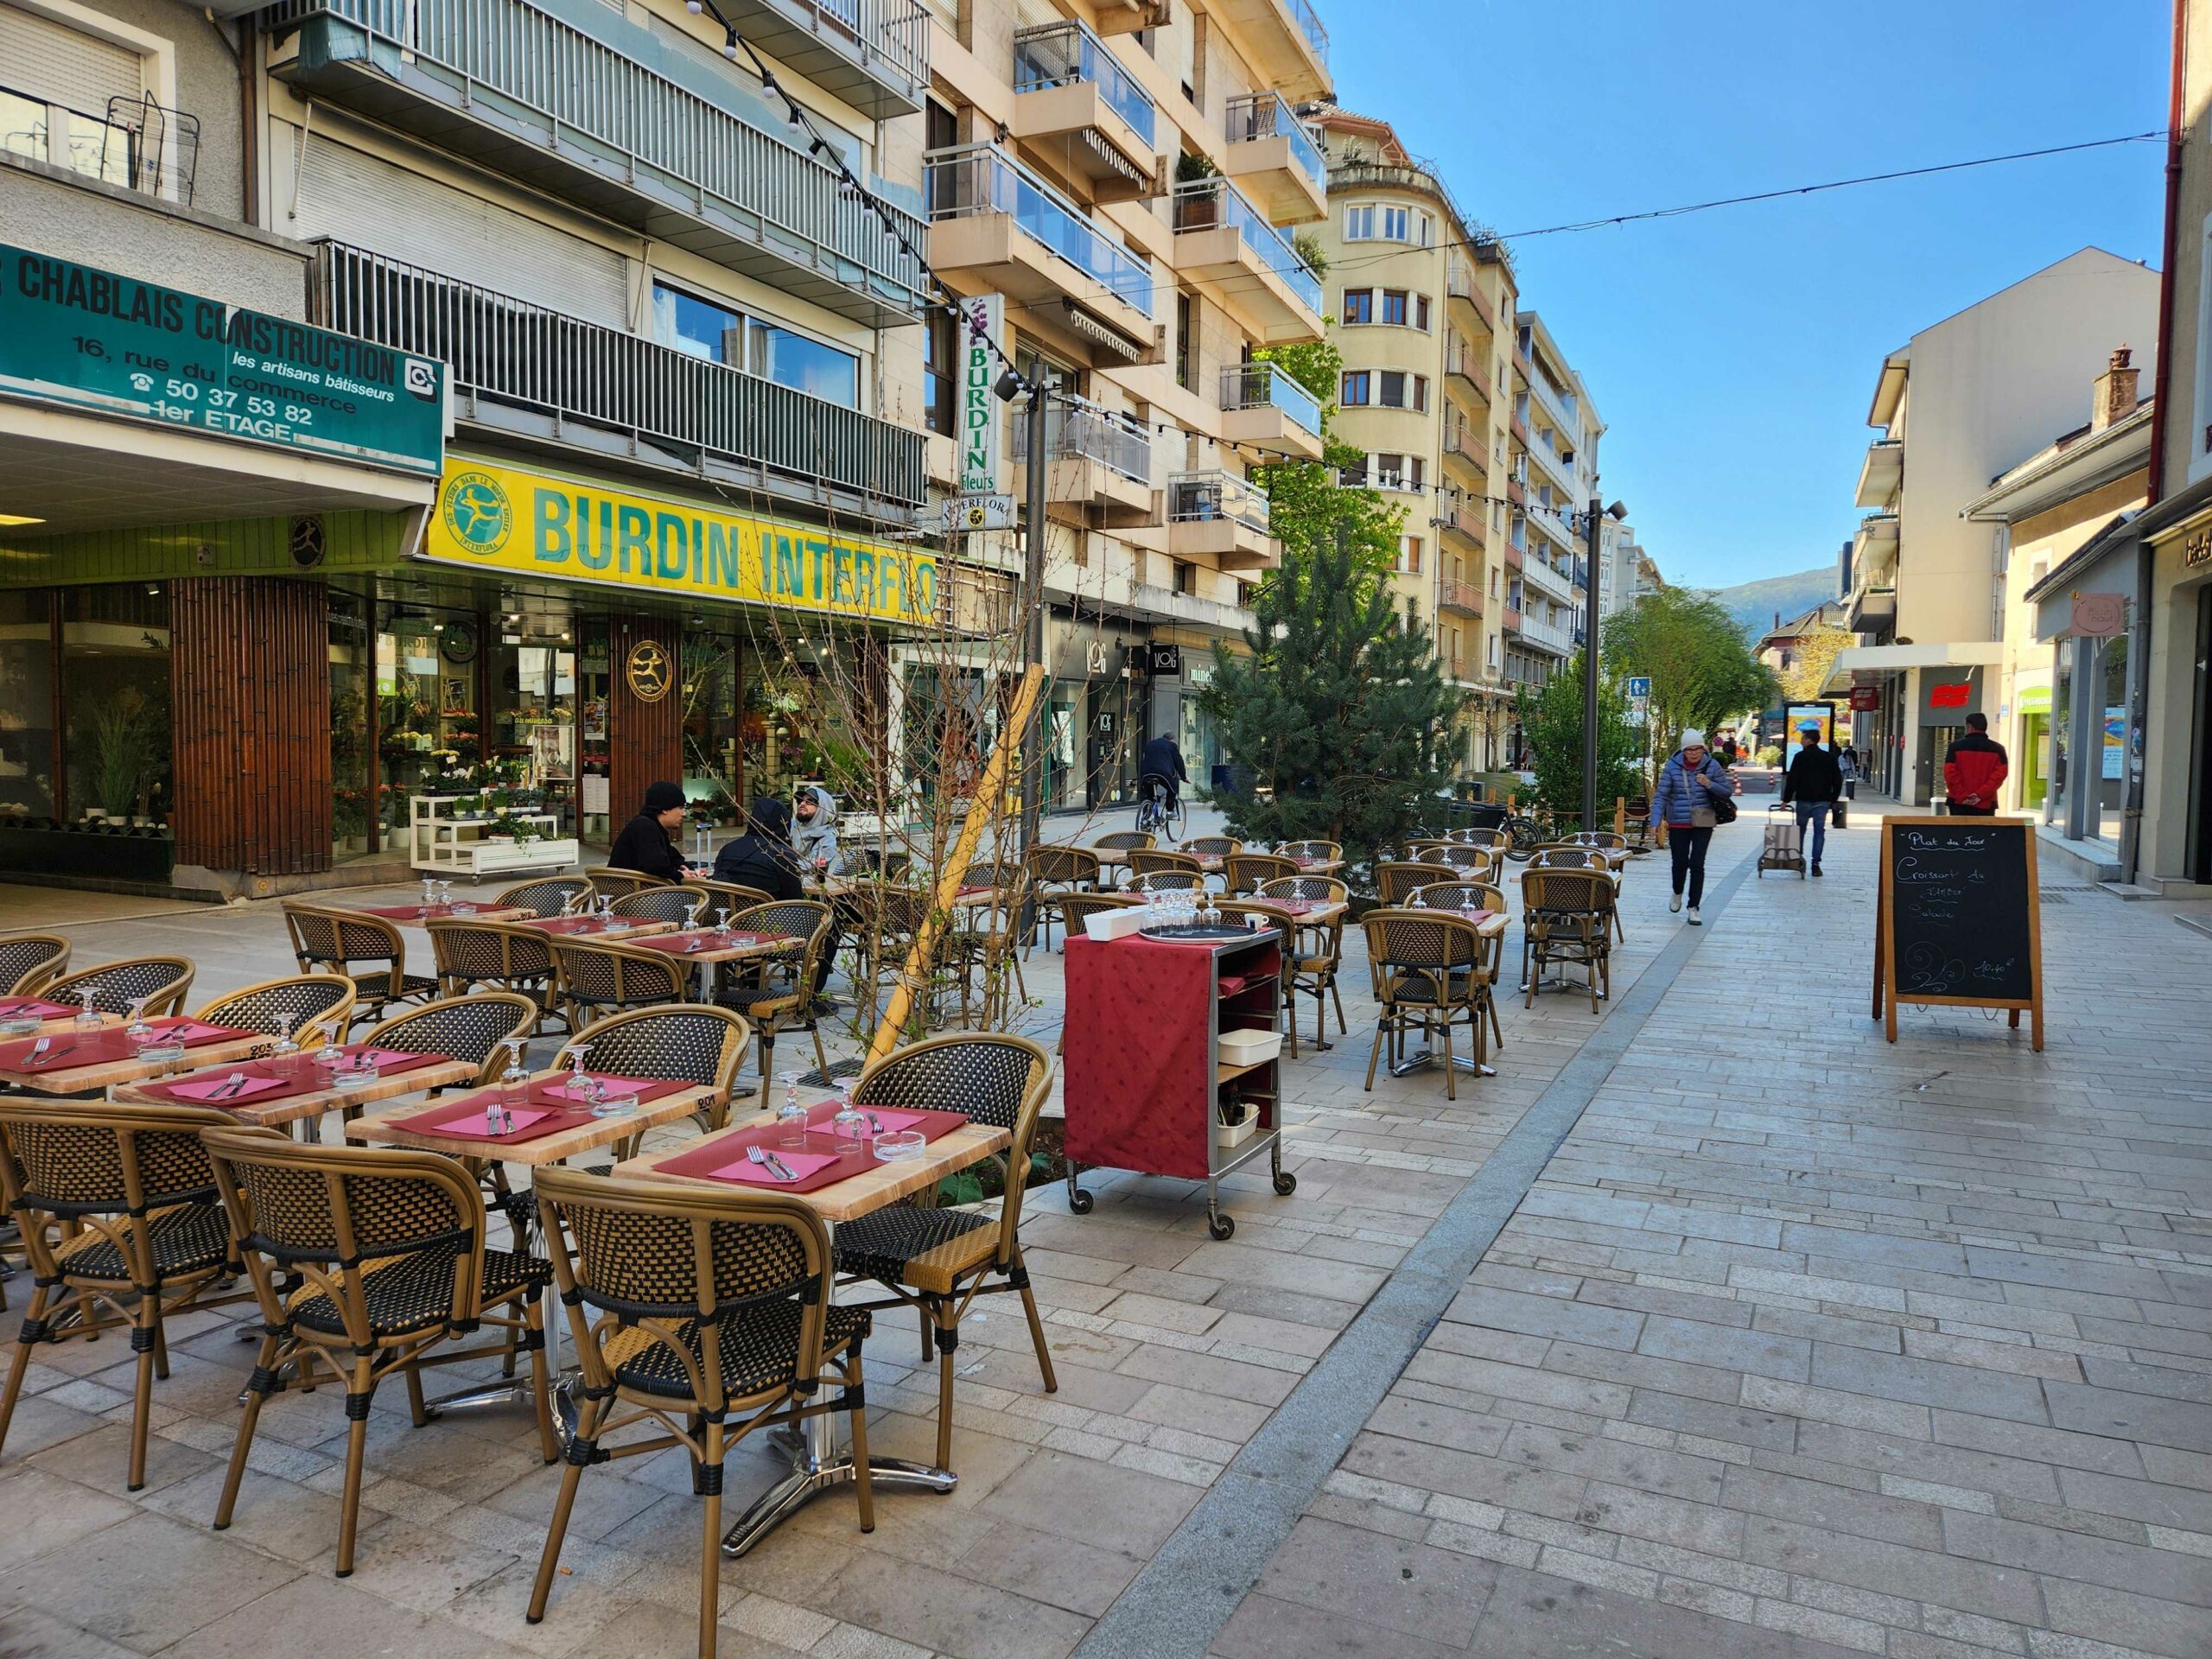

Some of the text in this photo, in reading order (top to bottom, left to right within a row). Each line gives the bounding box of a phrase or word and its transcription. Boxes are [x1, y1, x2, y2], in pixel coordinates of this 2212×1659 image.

[18, 256, 395, 386] CHABLAIS CONSTRUCTION
[72, 336, 356, 414] 16, rue du commerce
[232, 352, 395, 403] les artisans bâtisseurs
[166, 378, 313, 425] 50 37 53 82
[968, 347, 988, 470] BURDIN
[154, 400, 291, 442] 1er ETAGE
[960, 474, 994, 490] Fleurs
[944, 499, 1009, 520] IERFLORA
[534, 487, 937, 616] BURDIN INTERFLO
[1085, 639, 1107, 674] VOG
[1154, 652, 1176, 668] VOG
[1908, 831, 1938, 846] Plat
[1896, 856, 1959, 880] Croissant
[698, 1094, 716, 1110] 201
